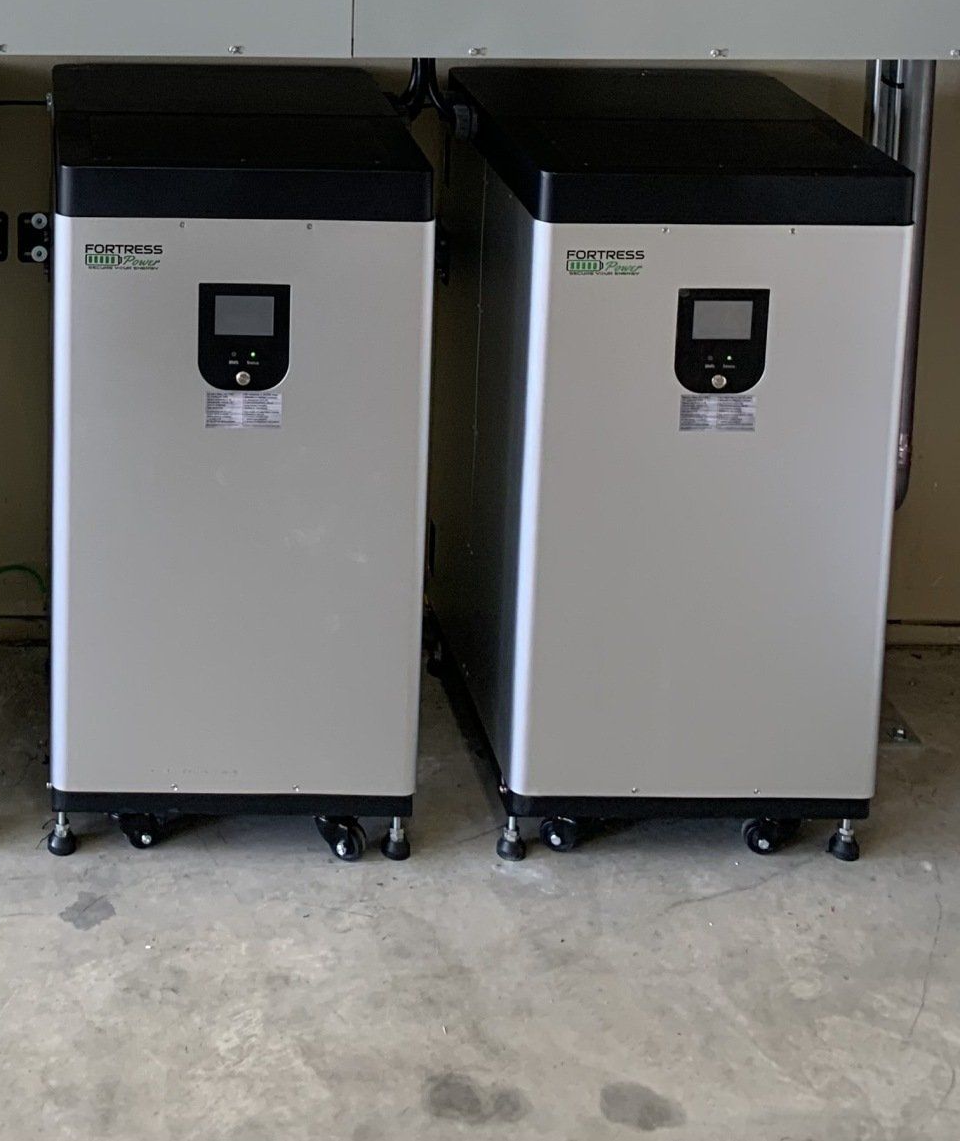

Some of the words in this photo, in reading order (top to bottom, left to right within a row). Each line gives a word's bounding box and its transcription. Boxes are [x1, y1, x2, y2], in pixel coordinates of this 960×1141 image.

[85, 244, 163, 254] FORTRESS
[566, 250, 645, 260] FORTRESS
[123, 255, 161, 266] Power
[605, 260, 643, 272] Power
